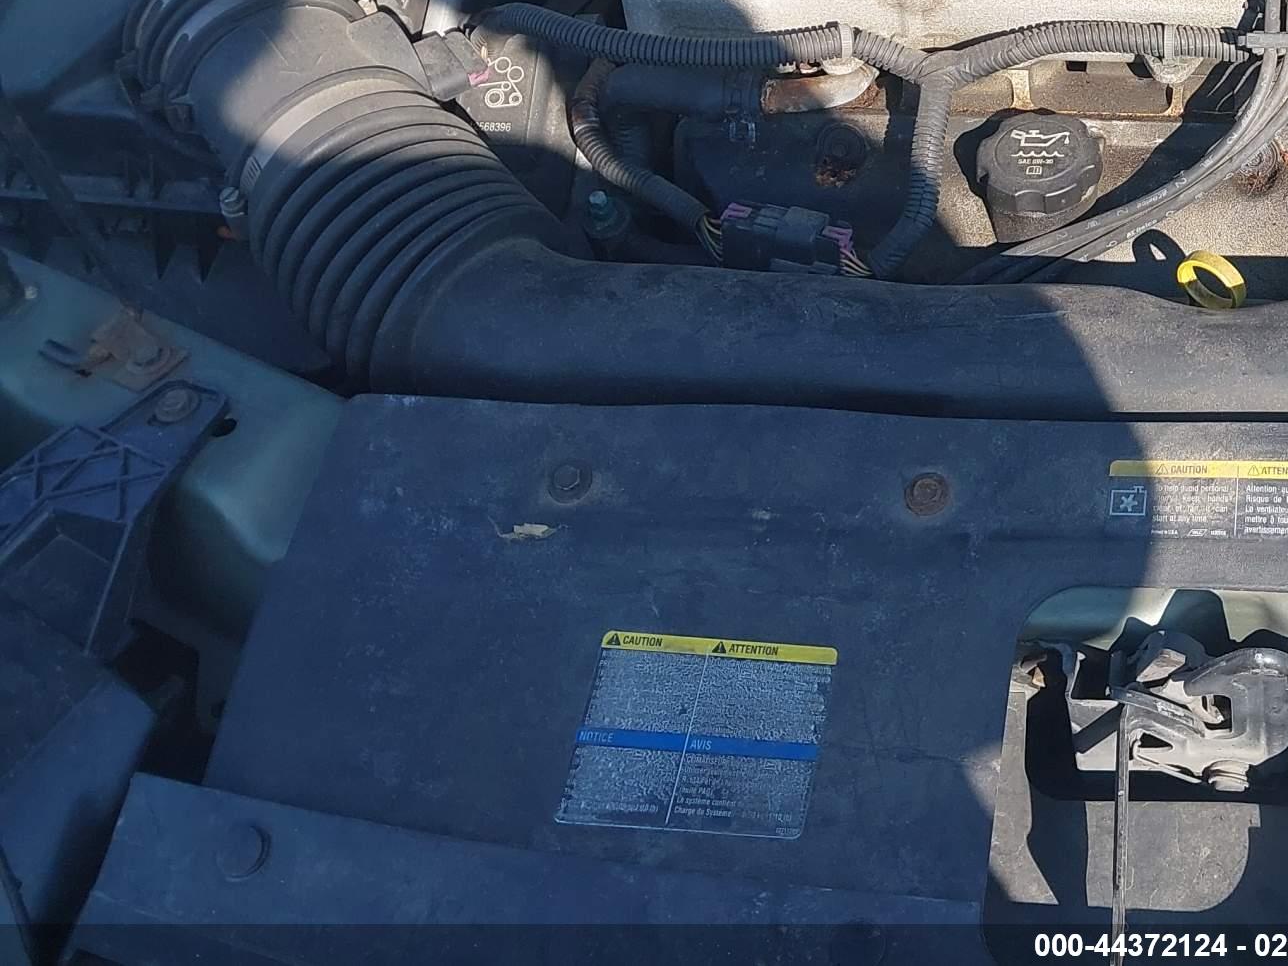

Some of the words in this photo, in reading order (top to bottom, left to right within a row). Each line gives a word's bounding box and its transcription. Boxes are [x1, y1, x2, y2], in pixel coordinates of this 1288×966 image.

[1171, 465, 1207, 474] CAUTION
[1246, 484, 1277, 493] Attention
[1246, 494, 1269, 503] Risque
[1273, 495, 1282, 503] de
[1244, 516, 1267, 524] mettre
[622, 636, 663, 647] CAUTION
[728, 643, 779, 656] ATTENTION
[579, 730, 614, 743] NOTICE
[689, 739, 712, 751] AVIS
[674, 806, 696, 816] Charge
